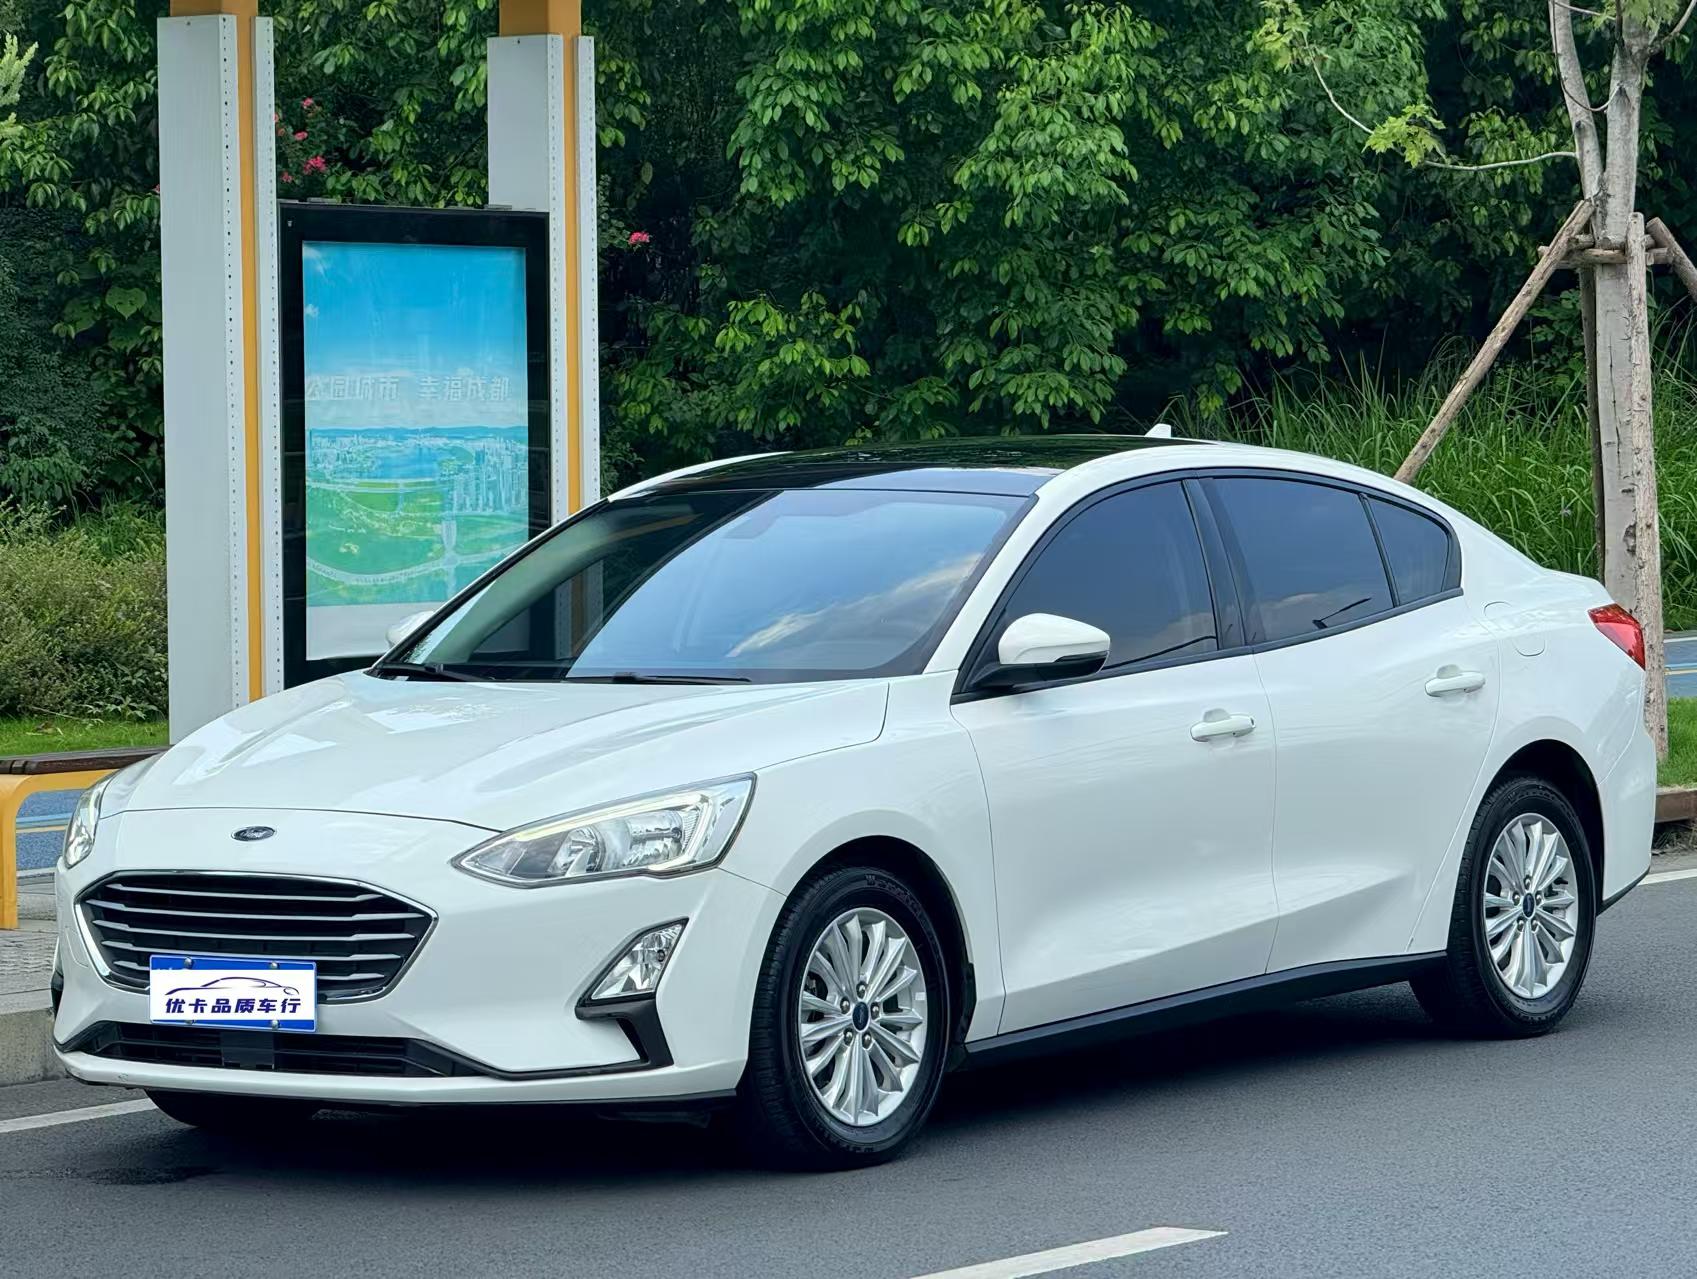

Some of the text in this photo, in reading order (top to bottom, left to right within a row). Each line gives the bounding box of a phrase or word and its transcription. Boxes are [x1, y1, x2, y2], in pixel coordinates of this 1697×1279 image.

[305, 375, 510, 401] 公园城市 幸福成都
